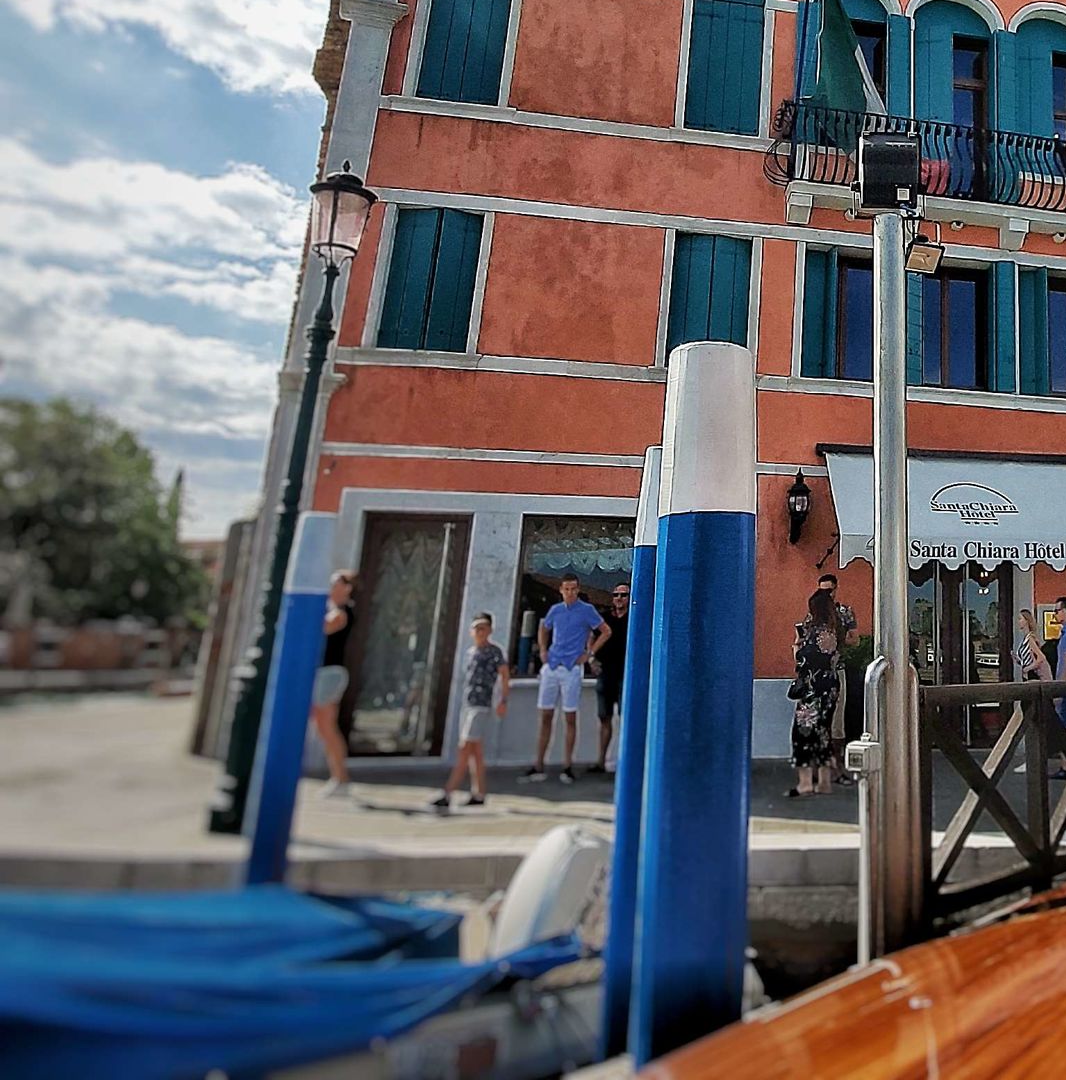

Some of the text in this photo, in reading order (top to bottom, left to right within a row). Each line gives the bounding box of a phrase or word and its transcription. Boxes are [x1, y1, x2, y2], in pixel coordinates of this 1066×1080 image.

[910, 540, 957, 558] Santa
[963, 541, 1019, 559] Chiara
[1024, 542, 1065, 559] Hôtel
